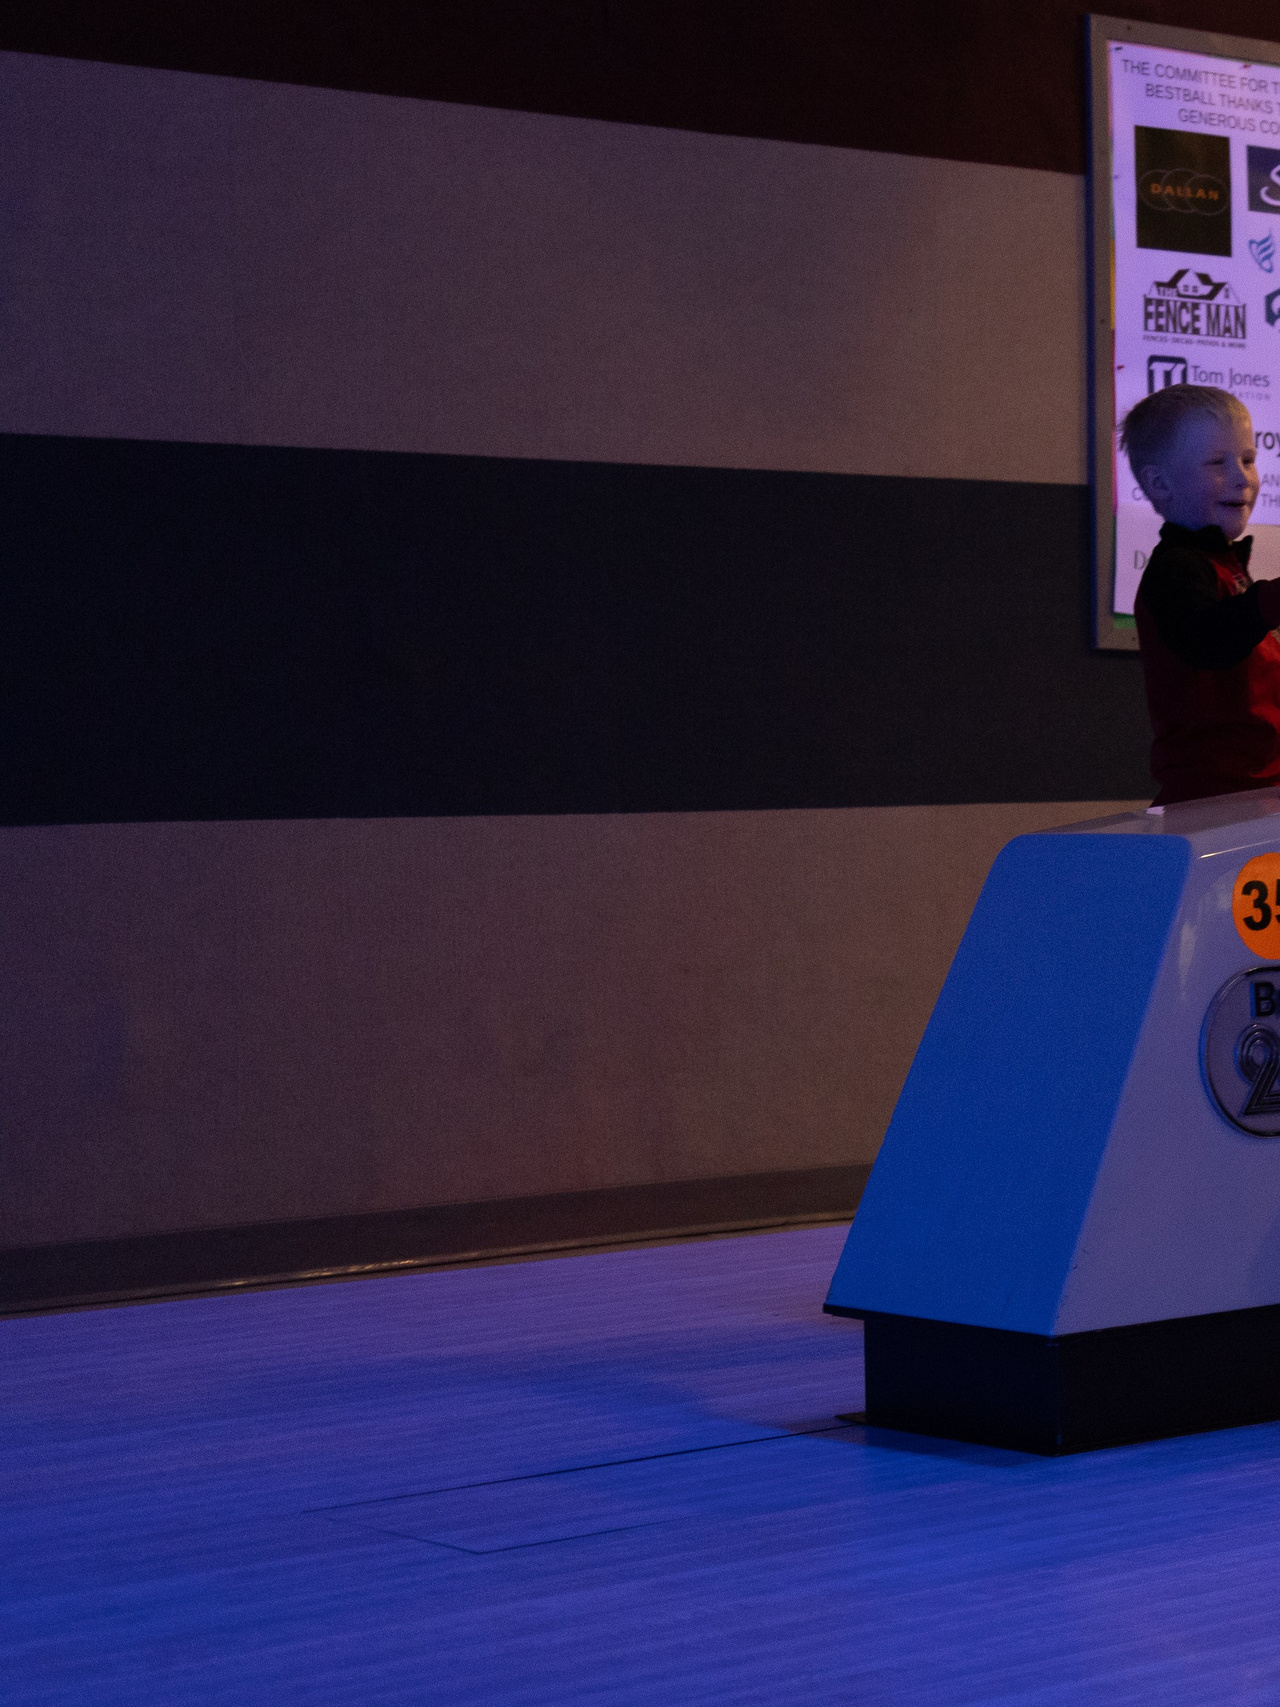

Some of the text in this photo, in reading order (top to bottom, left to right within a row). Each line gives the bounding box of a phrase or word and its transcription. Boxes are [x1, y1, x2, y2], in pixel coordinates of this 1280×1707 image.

[1121, 58, 1150, 76] THE
[1154, 64, 1236, 89] COMMITTEE
[1240, 76, 1268, 93] FOR
[1145, 83, 1217, 106] BESTBALL
[1219, 93, 1273, 114] THANKS
[1178, 108, 1256, 133] GENEROUS
[1143, 295, 1247, 339] FENCE MAN
[1191, 365, 1224, 384] Tom
[1228, 368, 1270, 388] Jones
